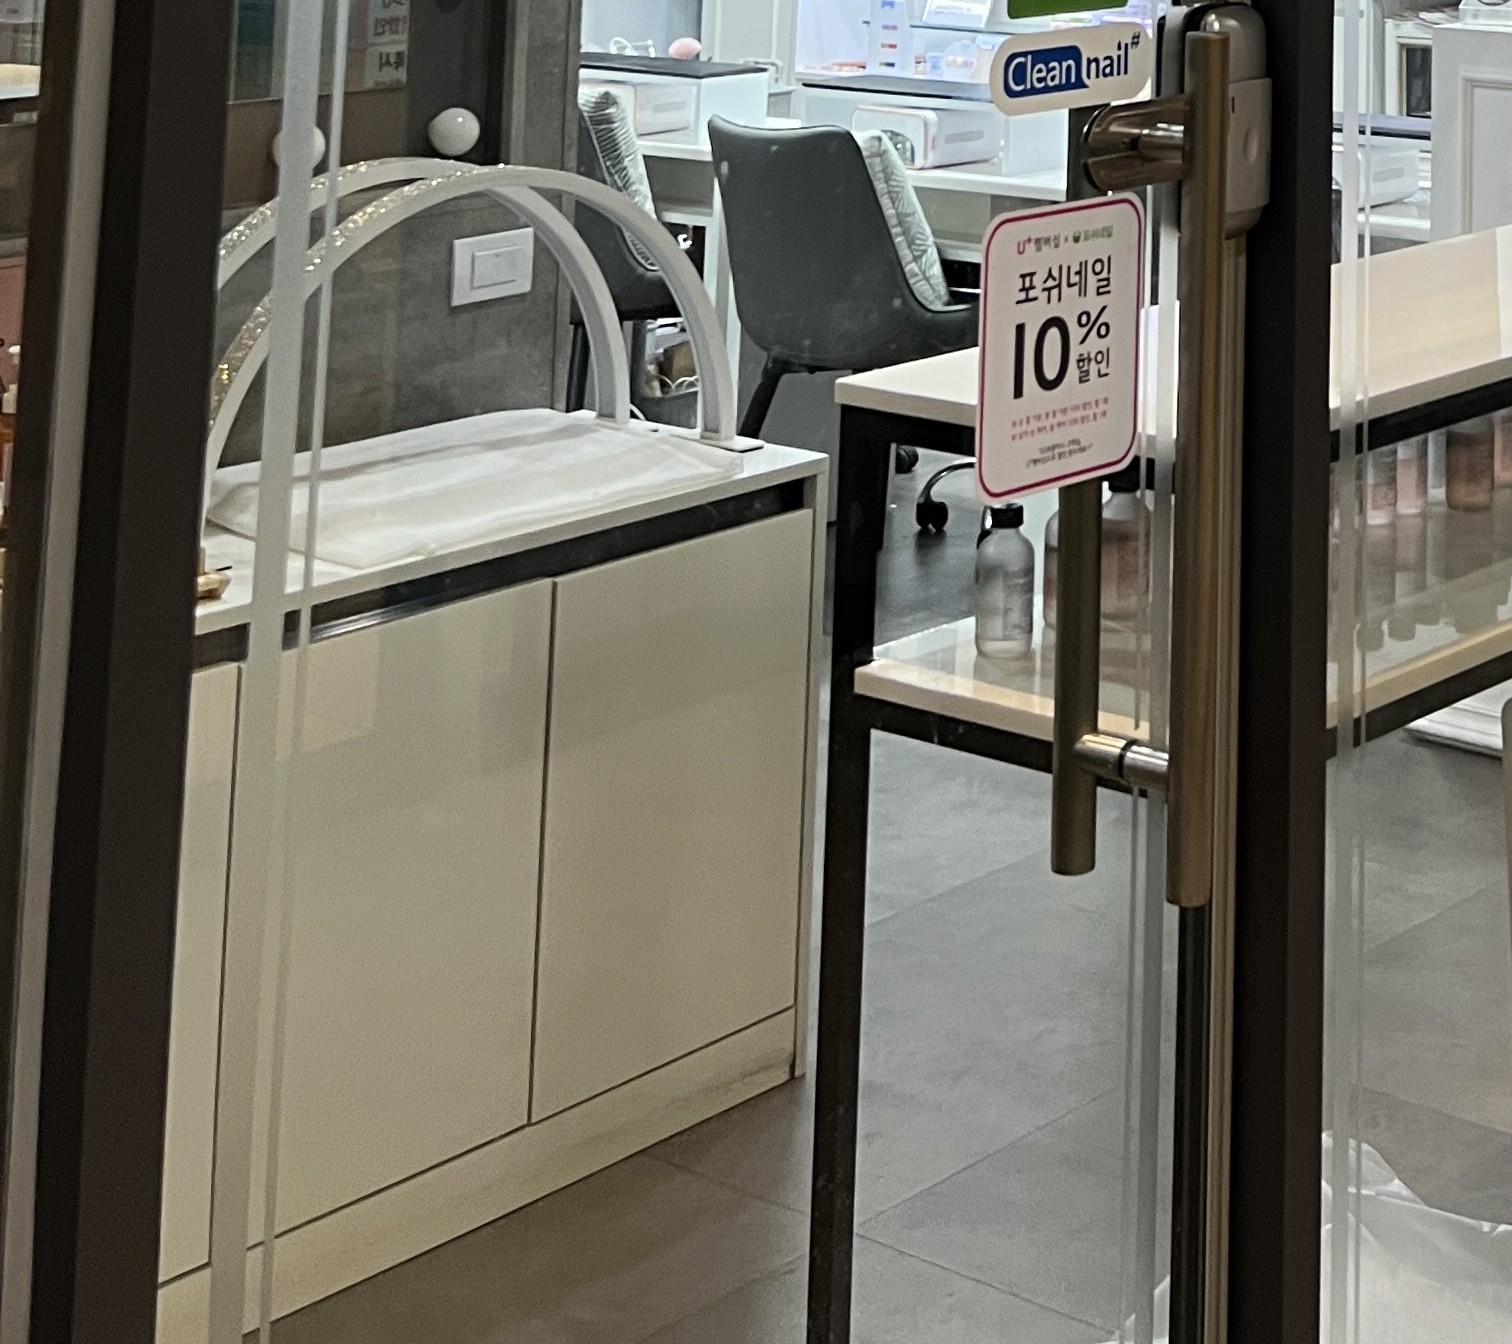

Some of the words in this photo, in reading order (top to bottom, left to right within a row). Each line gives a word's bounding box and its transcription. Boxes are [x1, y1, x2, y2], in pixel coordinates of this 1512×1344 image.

[1007, 52, 1077, 92] Clean
[1015, 254, 1112, 306] 포쉬네일
[1076, 346, 1111, 385] 할인
